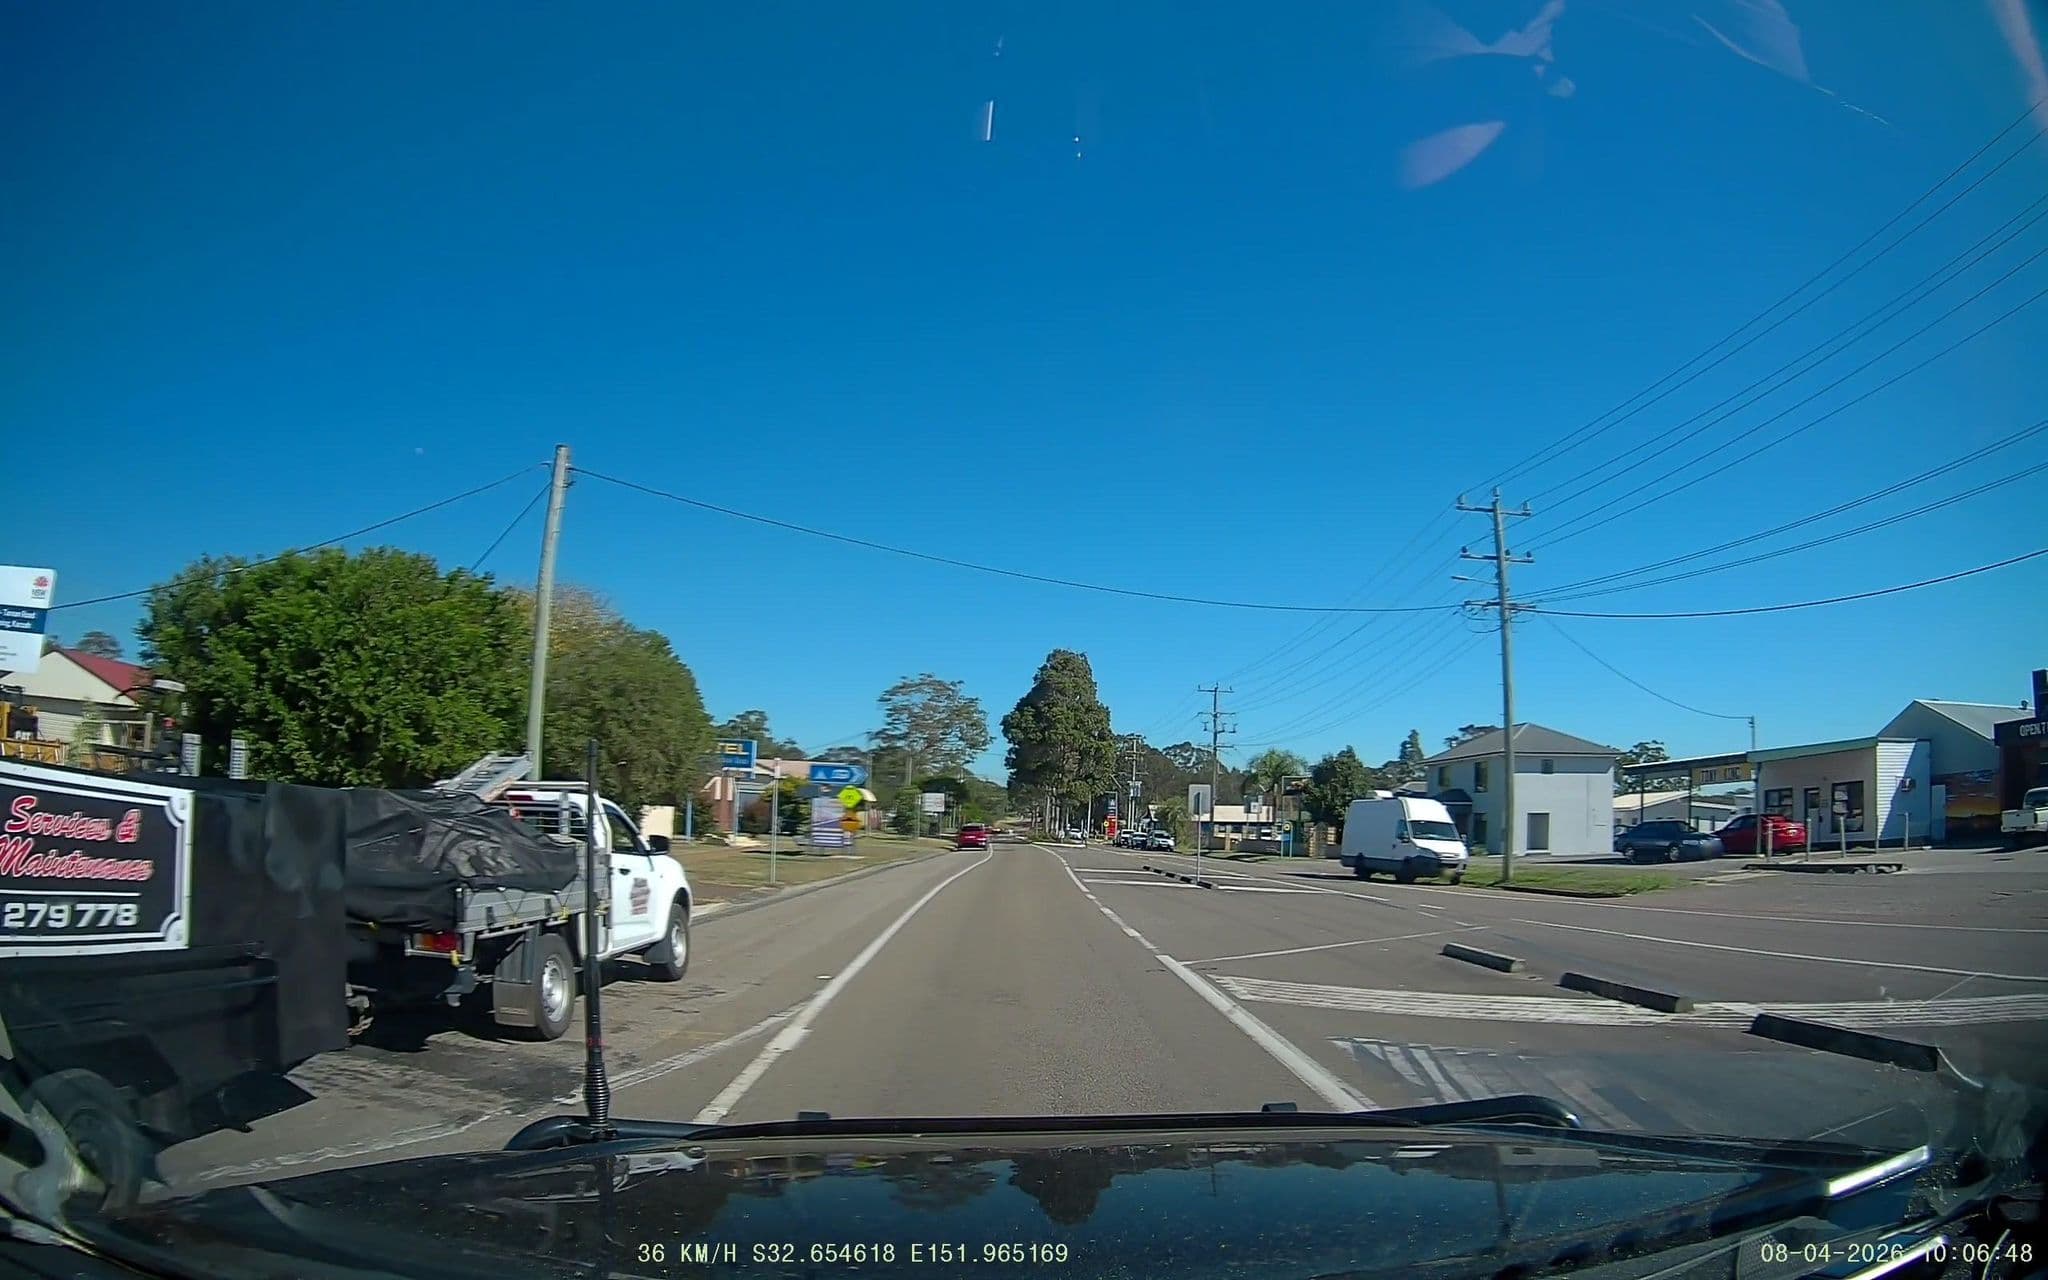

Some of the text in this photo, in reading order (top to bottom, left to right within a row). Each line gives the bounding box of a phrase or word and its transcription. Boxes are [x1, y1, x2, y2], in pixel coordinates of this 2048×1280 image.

[2020, 723, 2041, 736] OPEN
[5, 795, 142, 844] Services &
[0, 834, 155, 882] Maintenance
[3, 902, 139, 929] 279 778
